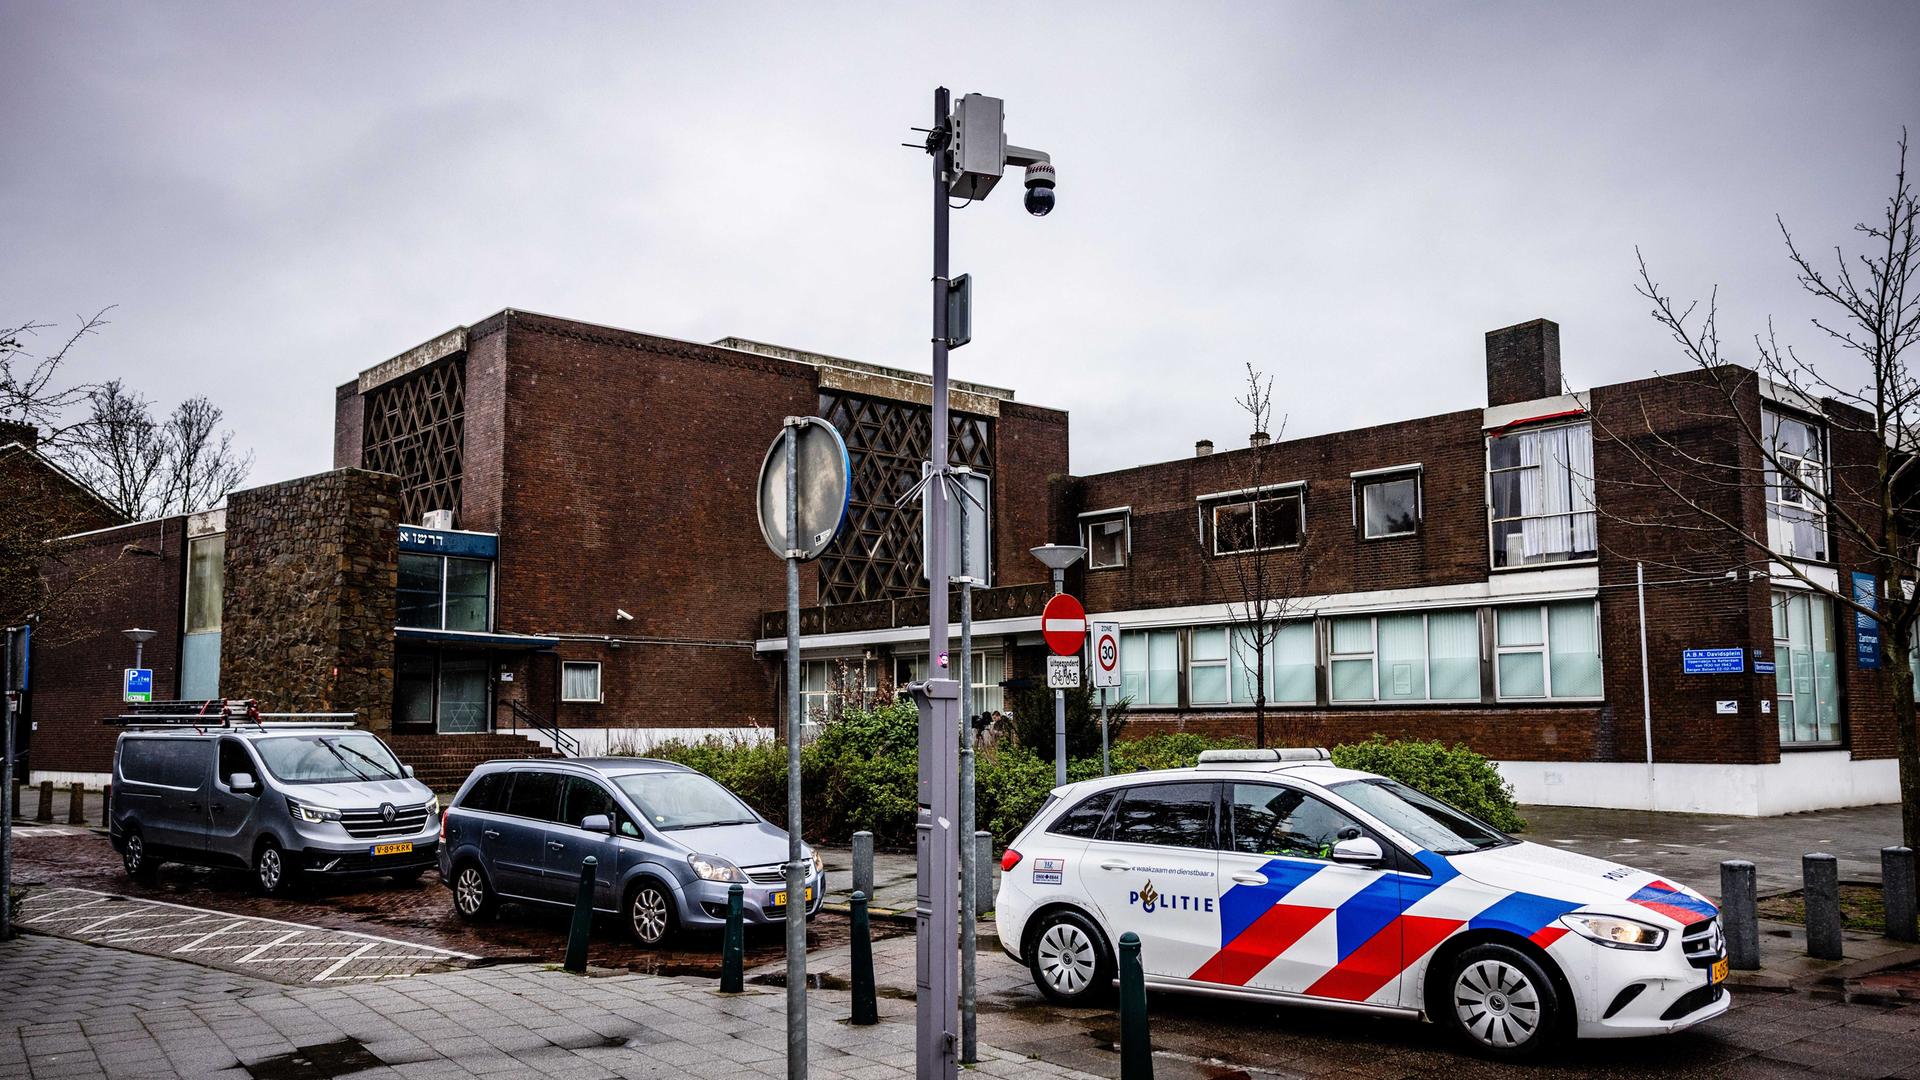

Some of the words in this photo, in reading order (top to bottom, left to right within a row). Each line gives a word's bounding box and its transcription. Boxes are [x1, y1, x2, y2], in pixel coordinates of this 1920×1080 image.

[413, 533, 443, 545] דרשו
[1102, 646, 1113, 660] 30
[1050, 660, 1079, 668] uitgezonderd
[130, 671, 138, 681] P
[377, 844, 410, 853] V-89-KRK
[1136, 866, 1168, 874] waakzaam
[1177, 868, 1209, 877] dienstbaar
[1130, 891, 1213, 913] POLITIE
